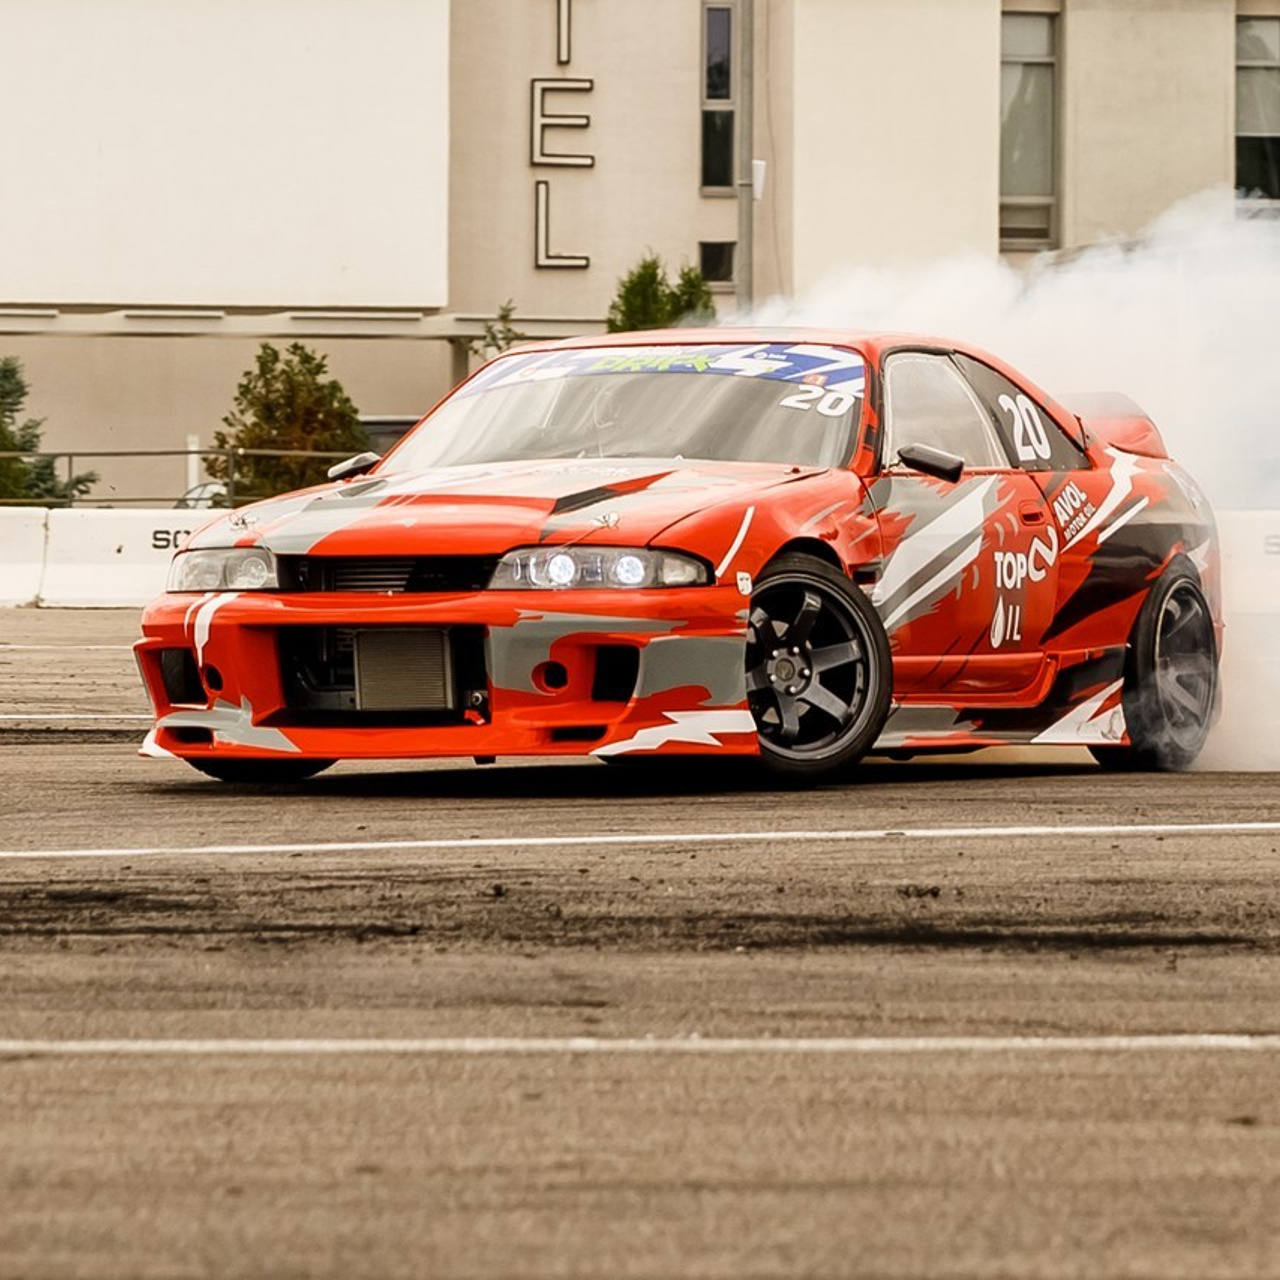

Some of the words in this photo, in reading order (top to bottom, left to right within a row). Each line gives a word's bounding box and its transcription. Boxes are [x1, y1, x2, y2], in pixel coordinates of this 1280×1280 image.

[779, 383, 856, 417] 20
[998, 394, 1051, 461] 20
[1053, 481, 1087, 527] AVOL
[994, 552, 1027, 589] TOP
